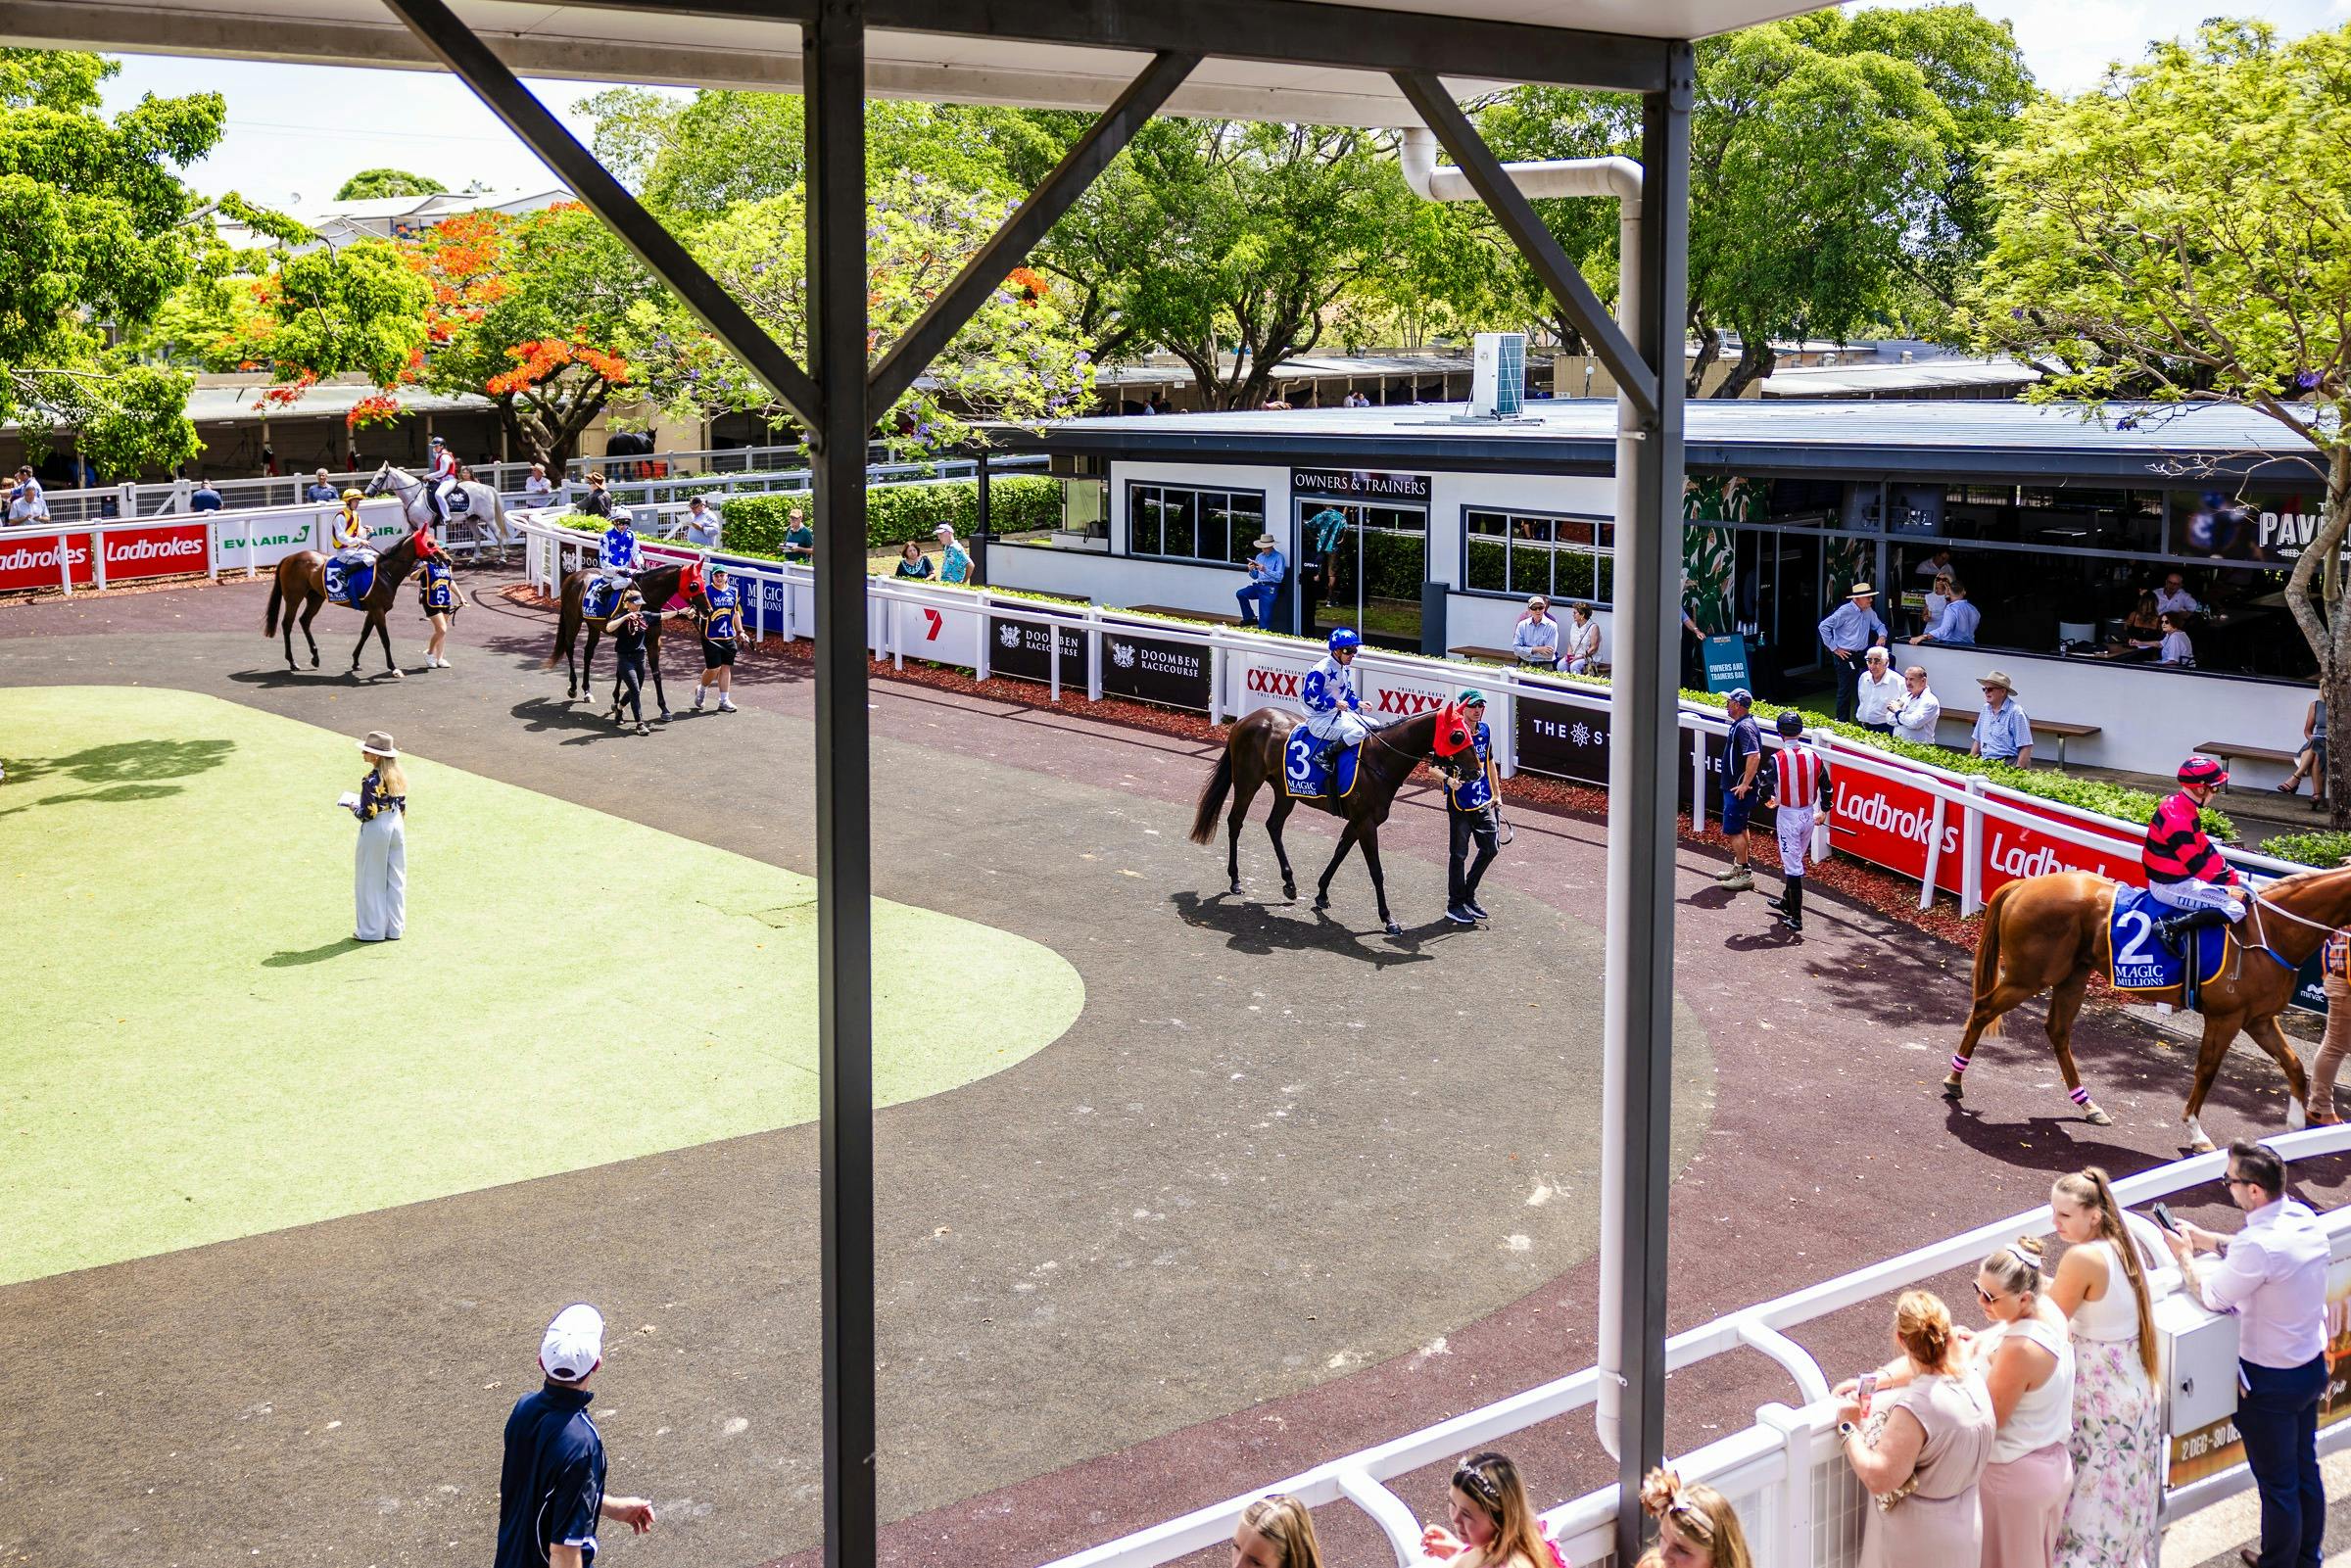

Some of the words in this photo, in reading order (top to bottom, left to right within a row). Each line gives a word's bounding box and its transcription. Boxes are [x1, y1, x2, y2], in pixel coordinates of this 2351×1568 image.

[1295, 473, 1348, 490] OWNERS
[1351, 477, 1361, 491] &
[1364, 478, 1426, 495] TRAINERS
[107, 536, 203, 562] Ladbrokes
[260, 535, 289, 546] AIR
[0, 546, 87, 571] adbrokes
[326, 567, 344, 593] 5
[437, 590, 446, 604] 5
[747, 583, 783, 602] MGIC
[718, 621, 728, 638] 4
[923, 608, 943, 641] 7
[1027, 630, 1079, 647] DOOBEN
[1027, 641, 1079, 657] RACECURSE
[1141, 648, 1199, 668] DOOMBEN
[1141, 660, 1199, 678] RACECOURSE
[1709, 664, 1732, 673] OWNERS
[1710, 672, 1734, 681] TRAINERS
[1533, 719, 1566, 738] THE
[1287, 739, 1311, 781] 3
[1287, 779, 1317, 791] MAGIC
[1472, 781, 1482, 806] 3
[2116, 909, 2154, 965] 2
[2114, 965, 2164, 978] MAGIC
[2116, 976, 2164, 987] MILLIONS
[2300, 990, 2326, 1003] mirvac
[2182, 1441, 2189, 1461] 2
[2189, 1433, 2208, 1458] DEC
